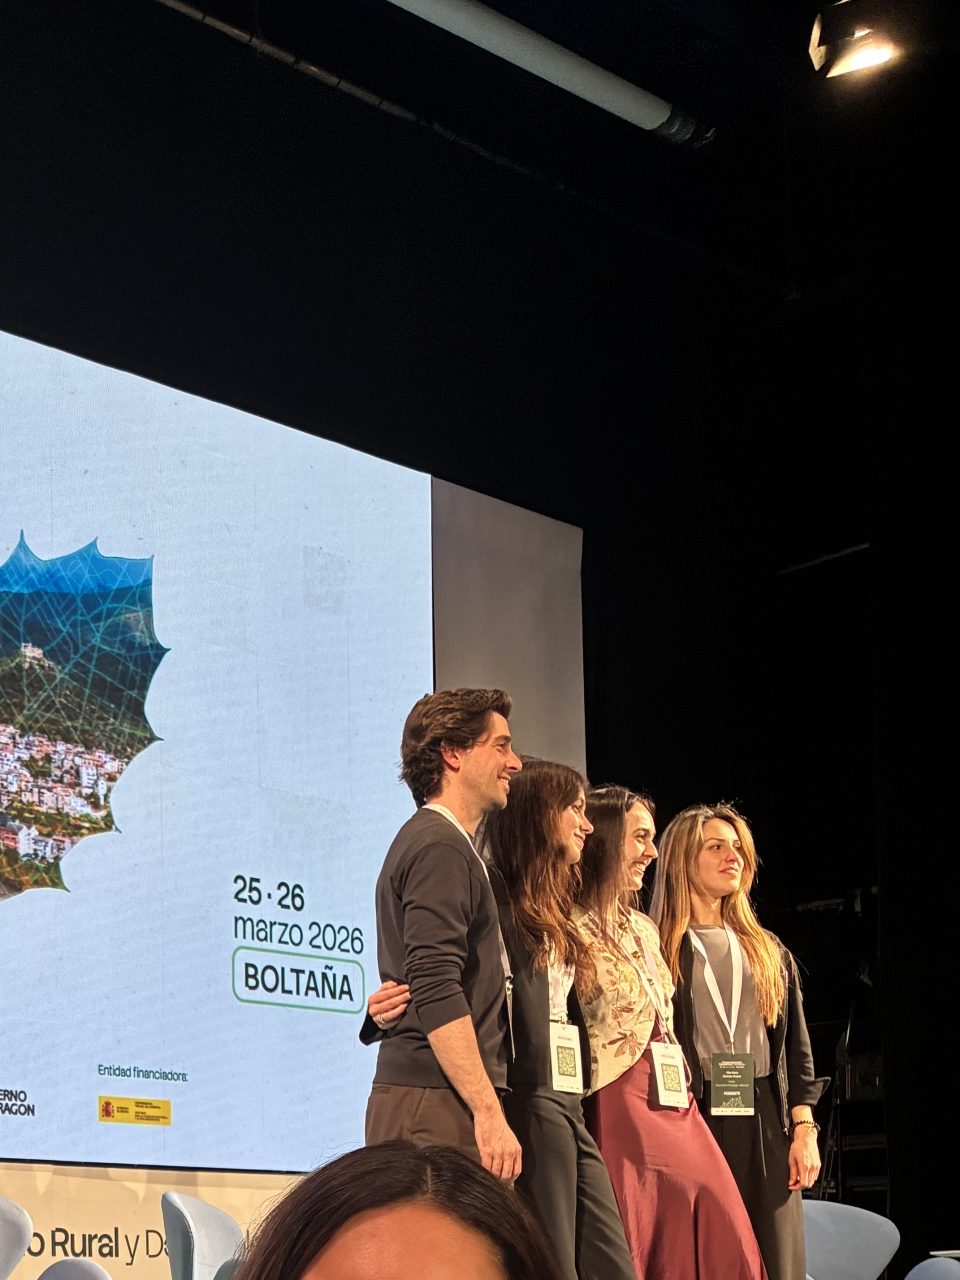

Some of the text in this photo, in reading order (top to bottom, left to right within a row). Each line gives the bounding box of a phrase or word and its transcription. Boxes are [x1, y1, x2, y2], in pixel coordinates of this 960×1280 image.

[233, 874, 262, 906] 25
[277, 881, 305, 912] 26
[234, 915, 365, 955] marzo 2026
[244, 963, 354, 1002] BOLTAÑA
[98, 1064, 189, 1082] Entidad financiadora:
[51, 1226, 120, 1258] Rural
[125, 1234, 140, 1266] y
